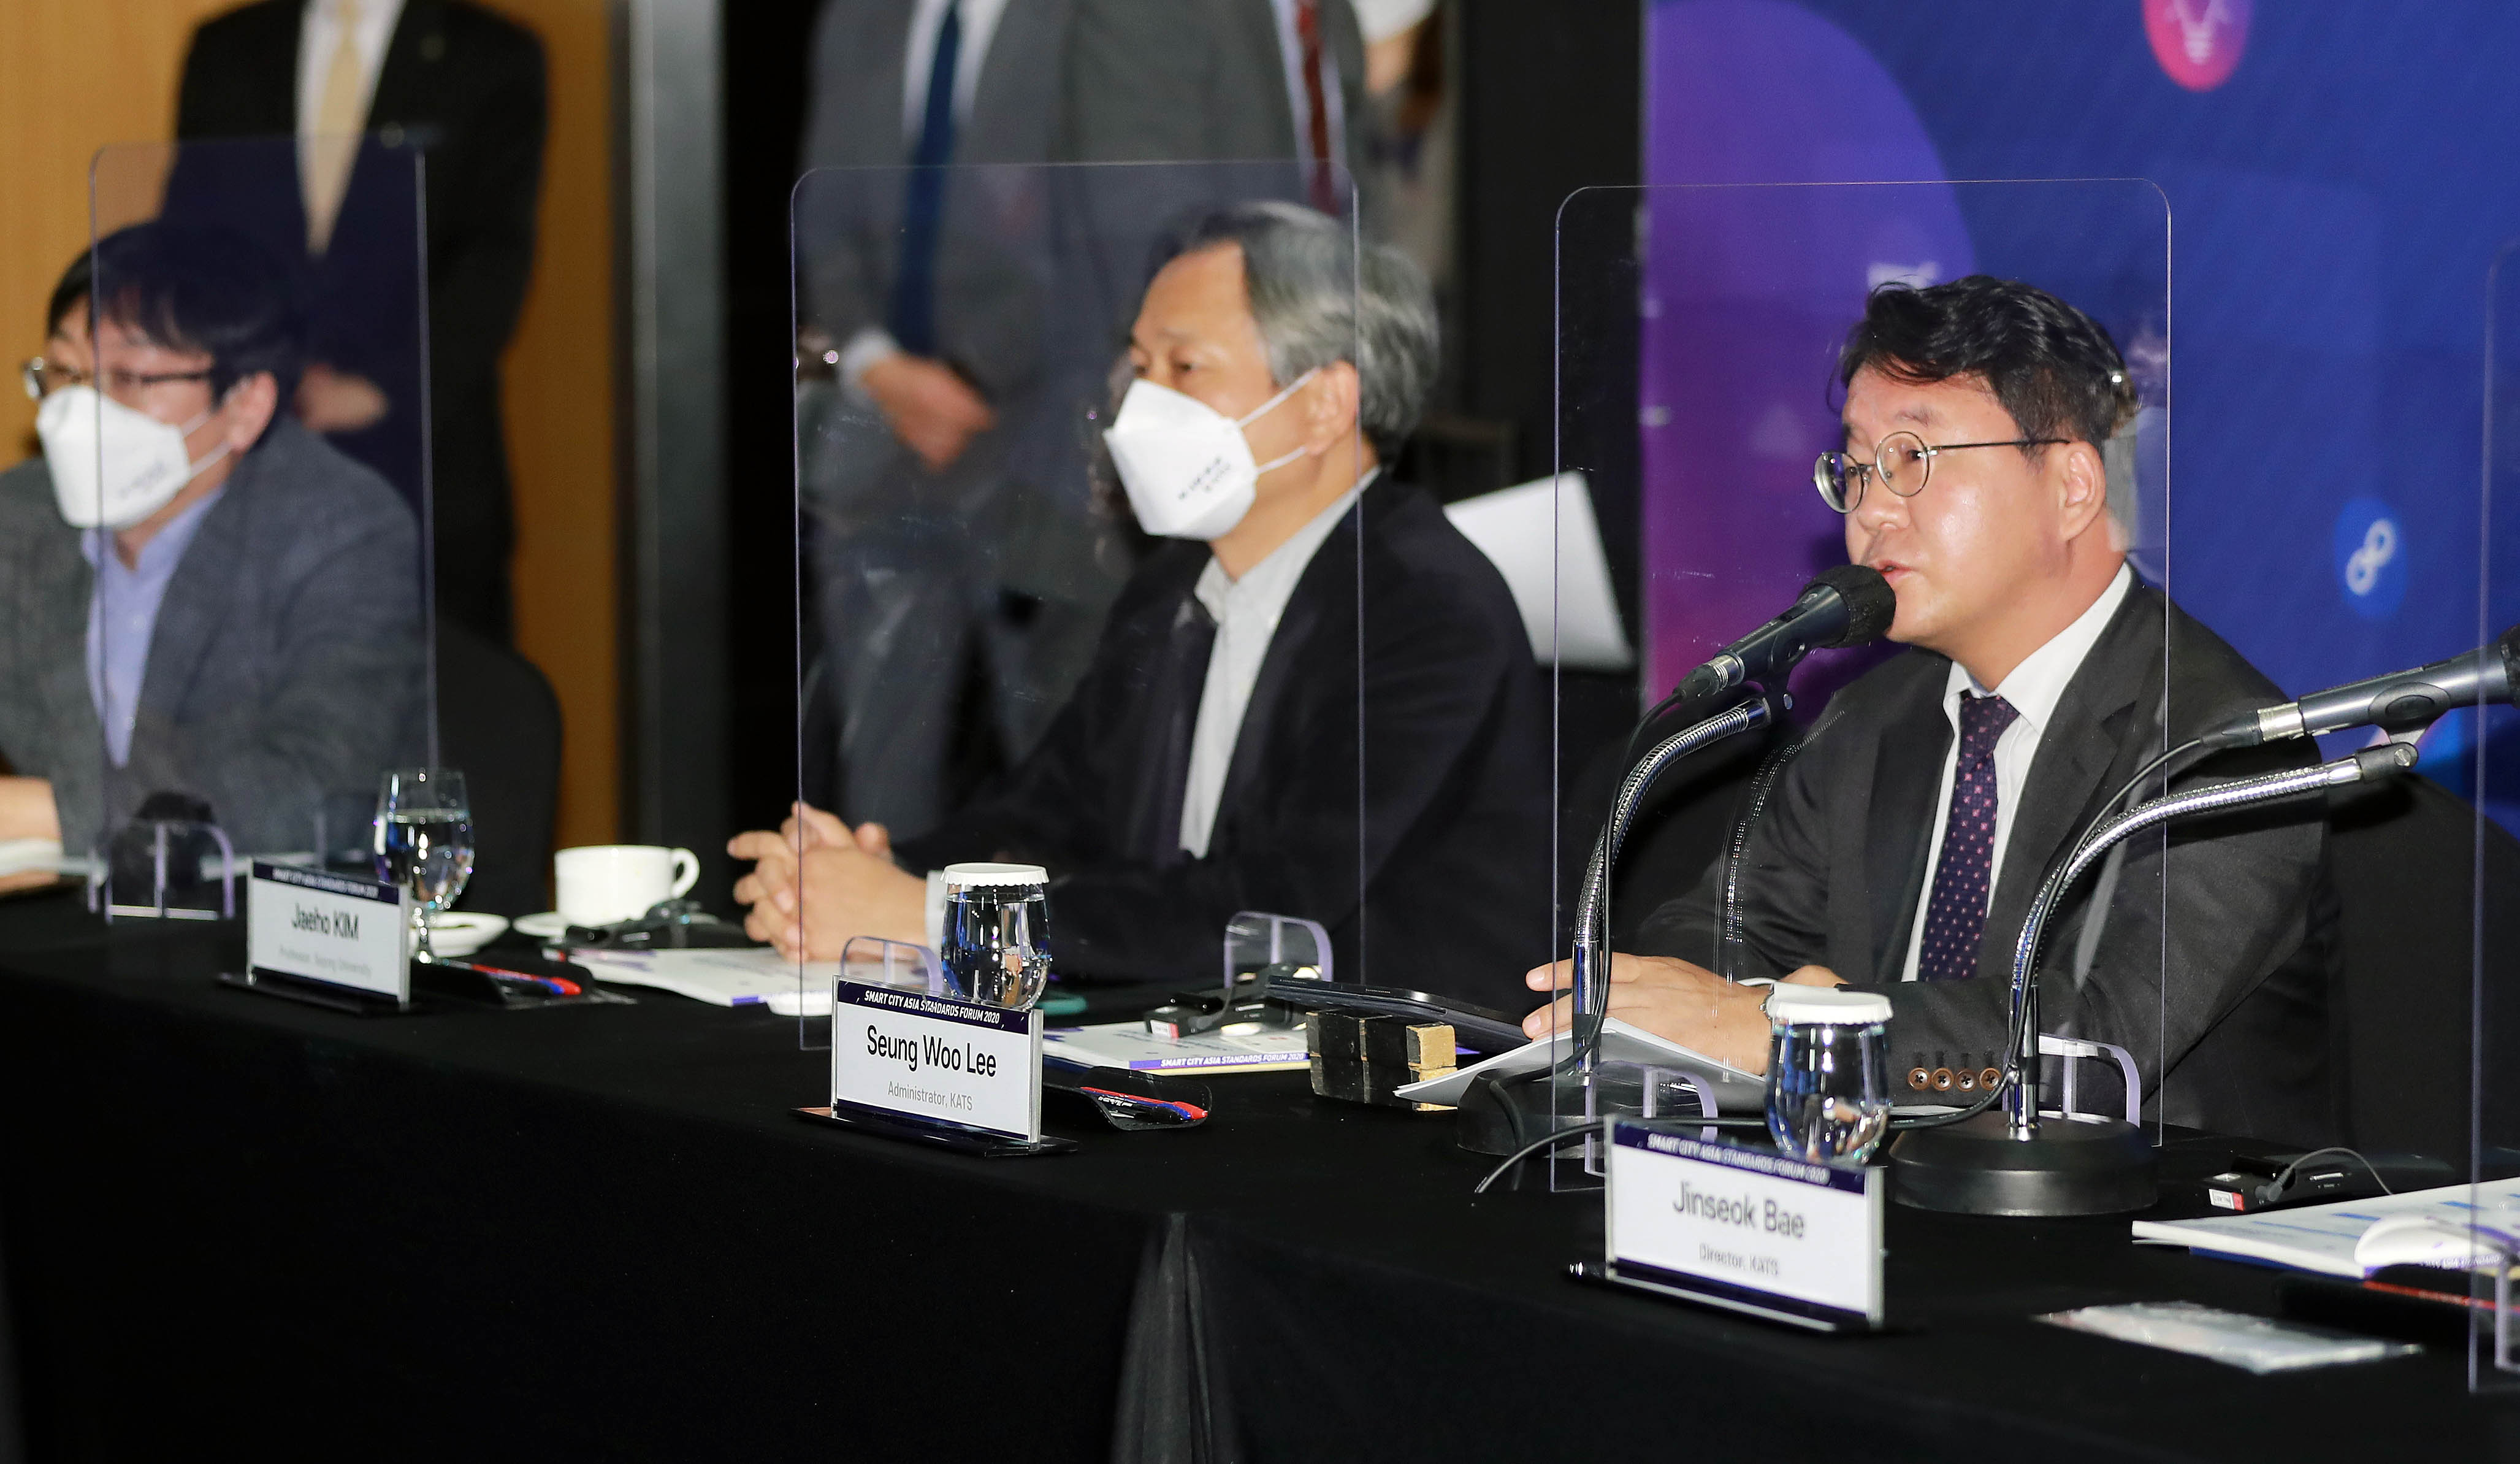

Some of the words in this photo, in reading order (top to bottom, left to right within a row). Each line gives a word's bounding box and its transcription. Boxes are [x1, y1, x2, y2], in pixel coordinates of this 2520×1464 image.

[333, 910, 359, 941] KIM
[864, 990, 888, 1005] SMART
[888, 994, 904, 1006] CITY
[903, 997, 920, 1010] ASIA
[920, 1000, 960, 1018] STANDARDS
[959, 1007, 984, 1022] FORUM
[983, 1011, 1001, 1024] 2020
[867, 1025, 917, 1071] Seung
[923, 1035, 961, 1070] Woo
[967, 1043, 996, 1077] Lee
[1161, 1058, 1186, 1067] SMART
[1186, 1057, 1204, 1066] CITY
[1204, 1056, 1221, 1065] ASIA
[1221, 1054, 1262, 1064] STANDARDS
[888, 1081, 947, 1108] Administrator,
[950, 1092, 972, 1111] KATS
[1648, 1133, 1680, 1153] SMART
[1679, 1140, 1700, 1157] CITY
[1774, 1157, 1806, 1179] FORUM
[1673, 1180, 1756, 1227] Jinseok
[1764, 1197, 1805, 1239] Bae
[1749, 1255, 1779, 1276] KATS
